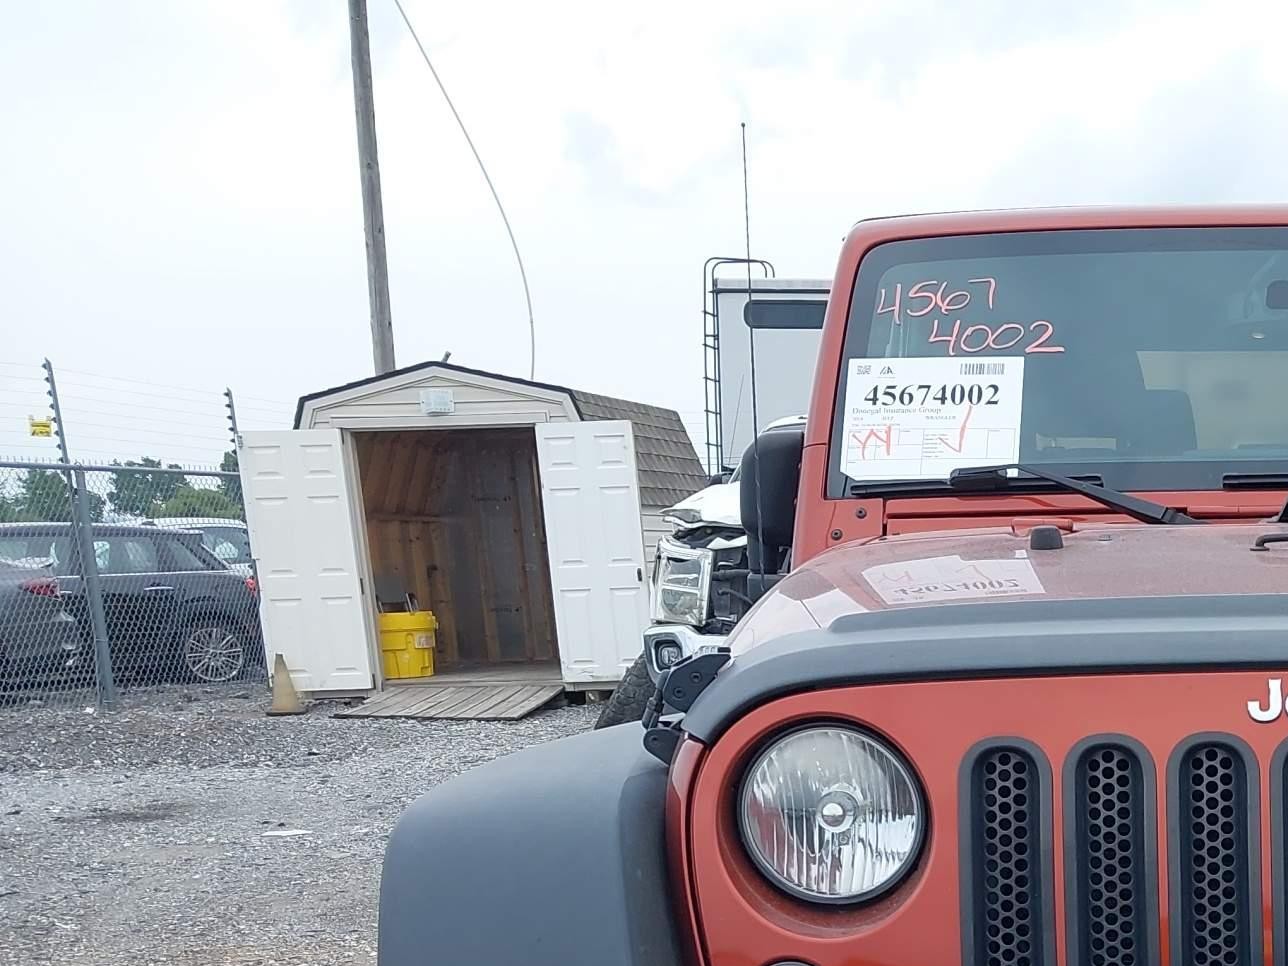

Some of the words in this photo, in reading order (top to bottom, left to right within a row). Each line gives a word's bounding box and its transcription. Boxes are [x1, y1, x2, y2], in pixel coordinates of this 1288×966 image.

[877, 277, 996, 324] 4567
[928, 319, 1065, 356] 4002
[864, 383, 1000, 406] 45674002
